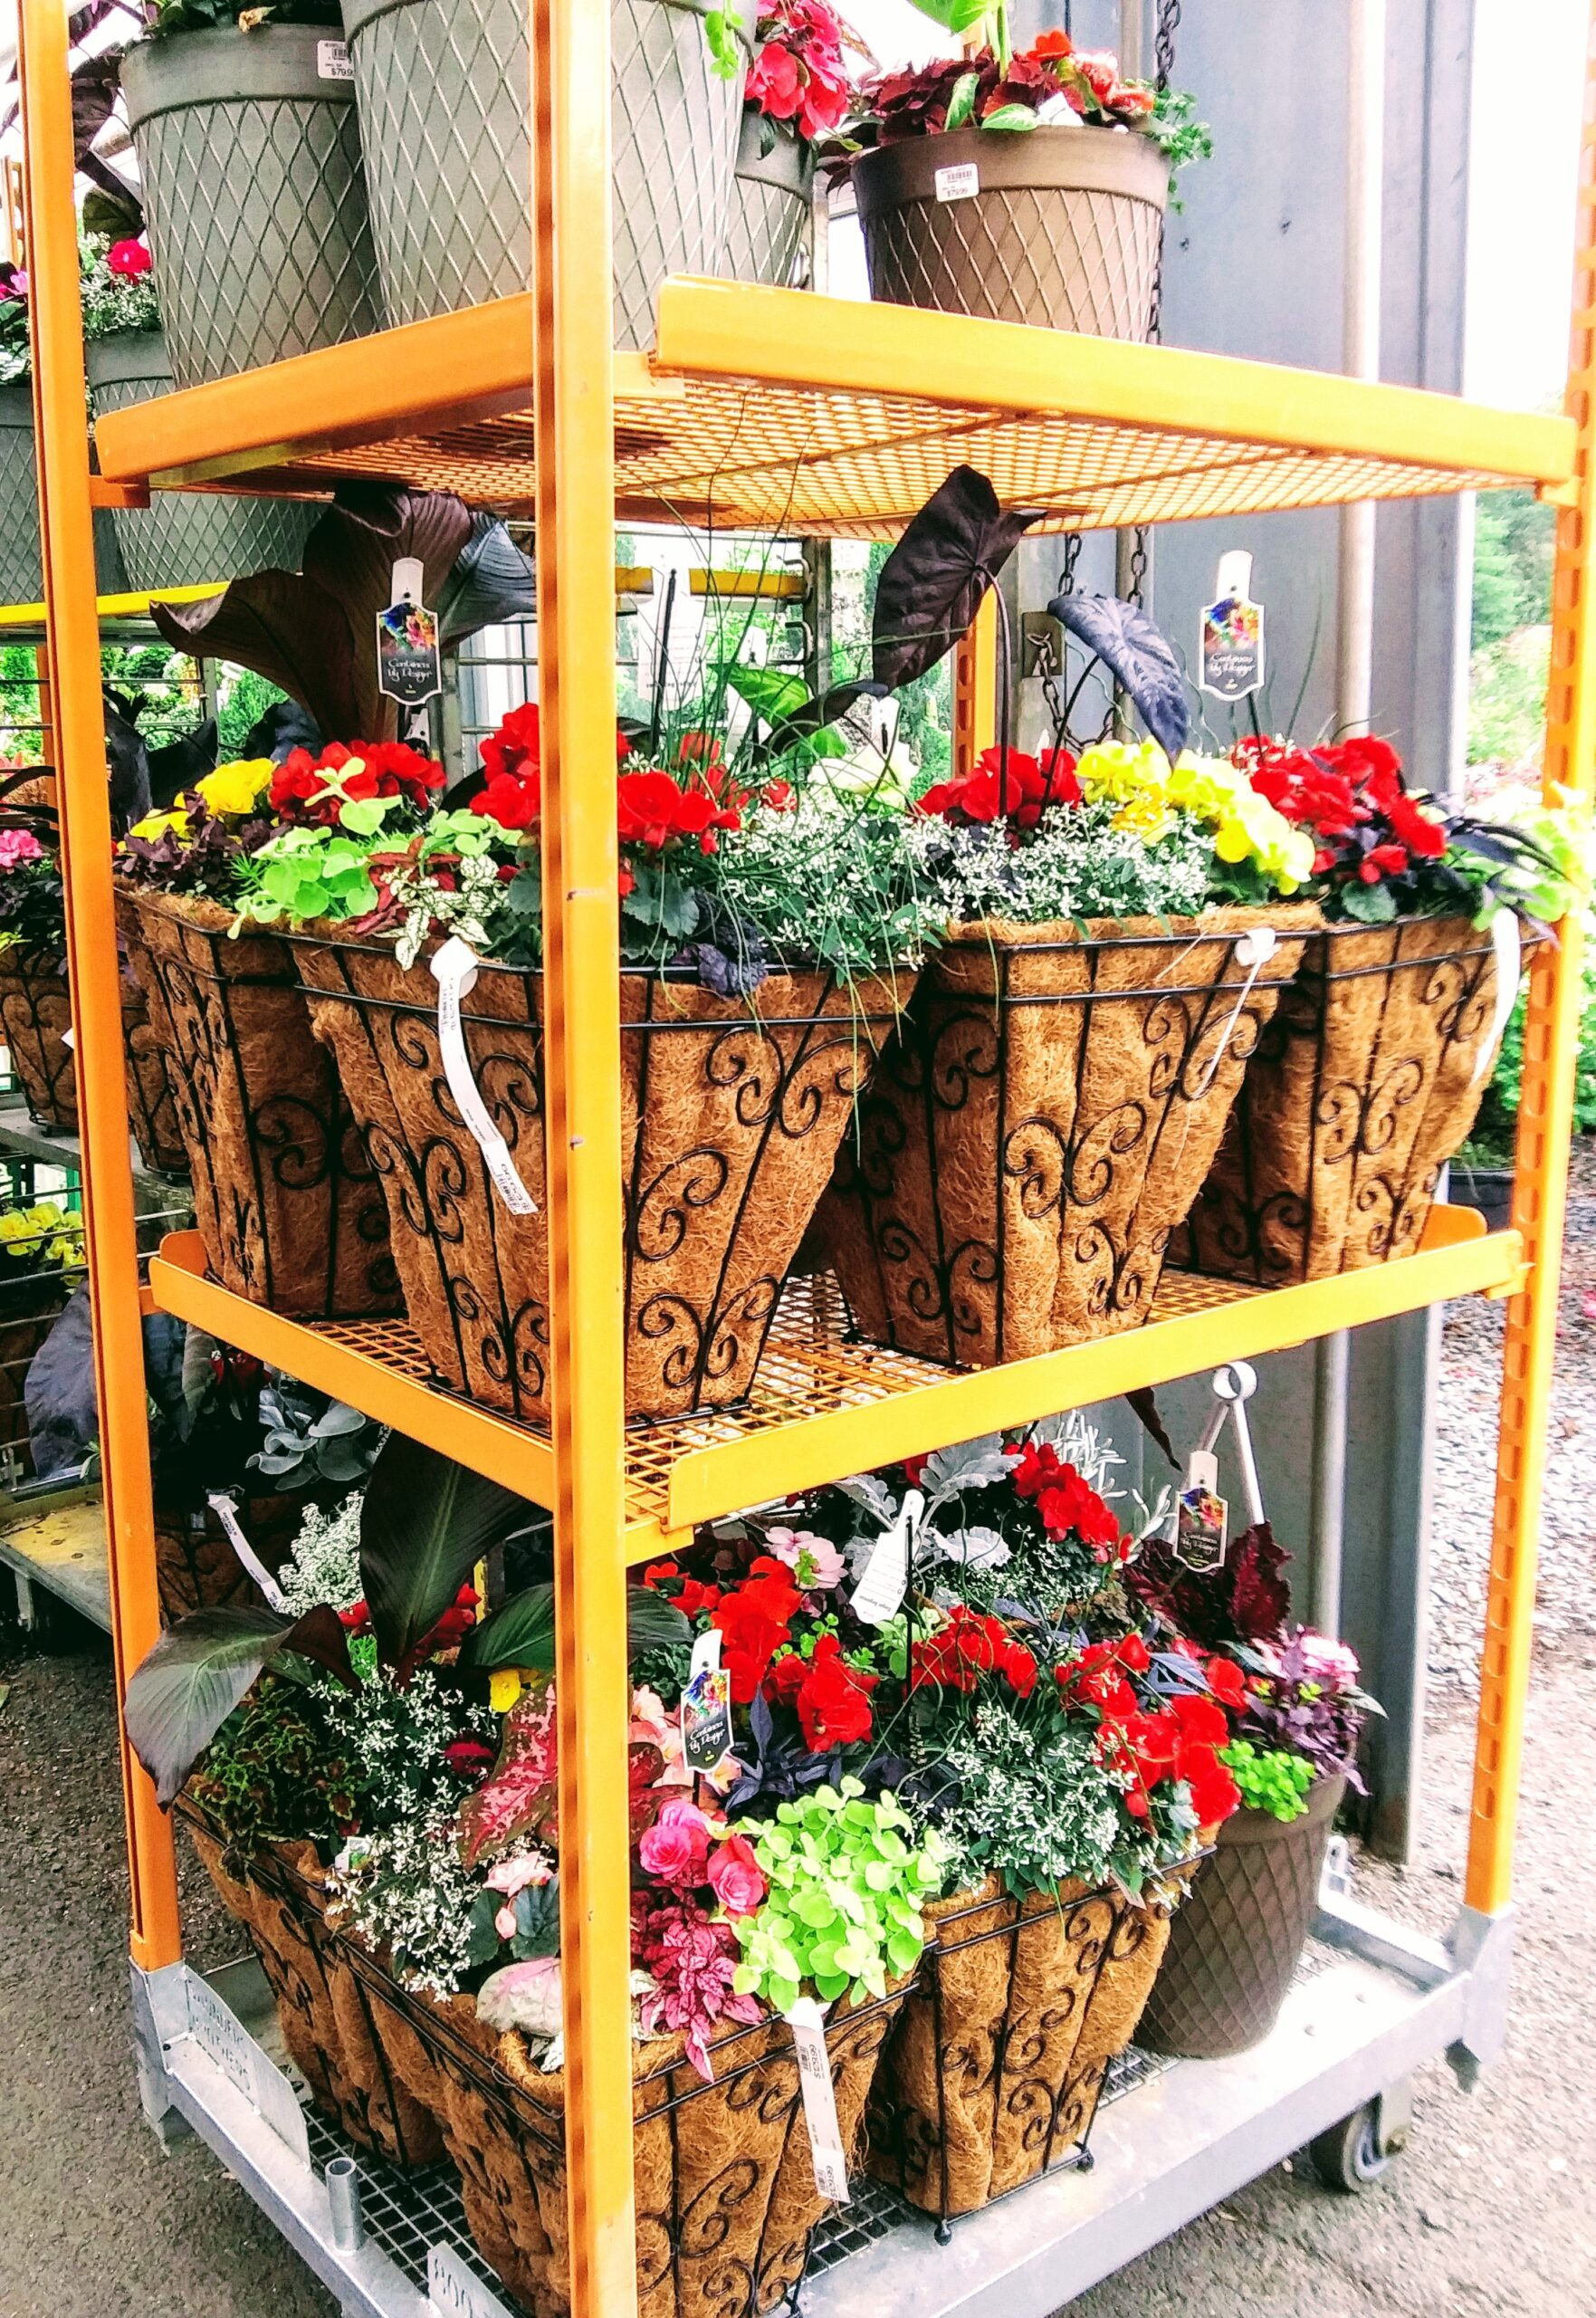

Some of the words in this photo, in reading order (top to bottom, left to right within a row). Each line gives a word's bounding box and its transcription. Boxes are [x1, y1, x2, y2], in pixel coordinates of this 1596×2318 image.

[387, 658, 430, 669] Containers
[402, 668, 433, 683] Design
[690, 1721, 723, 1740] Containers
[701, 1729, 726, 1746] Design
